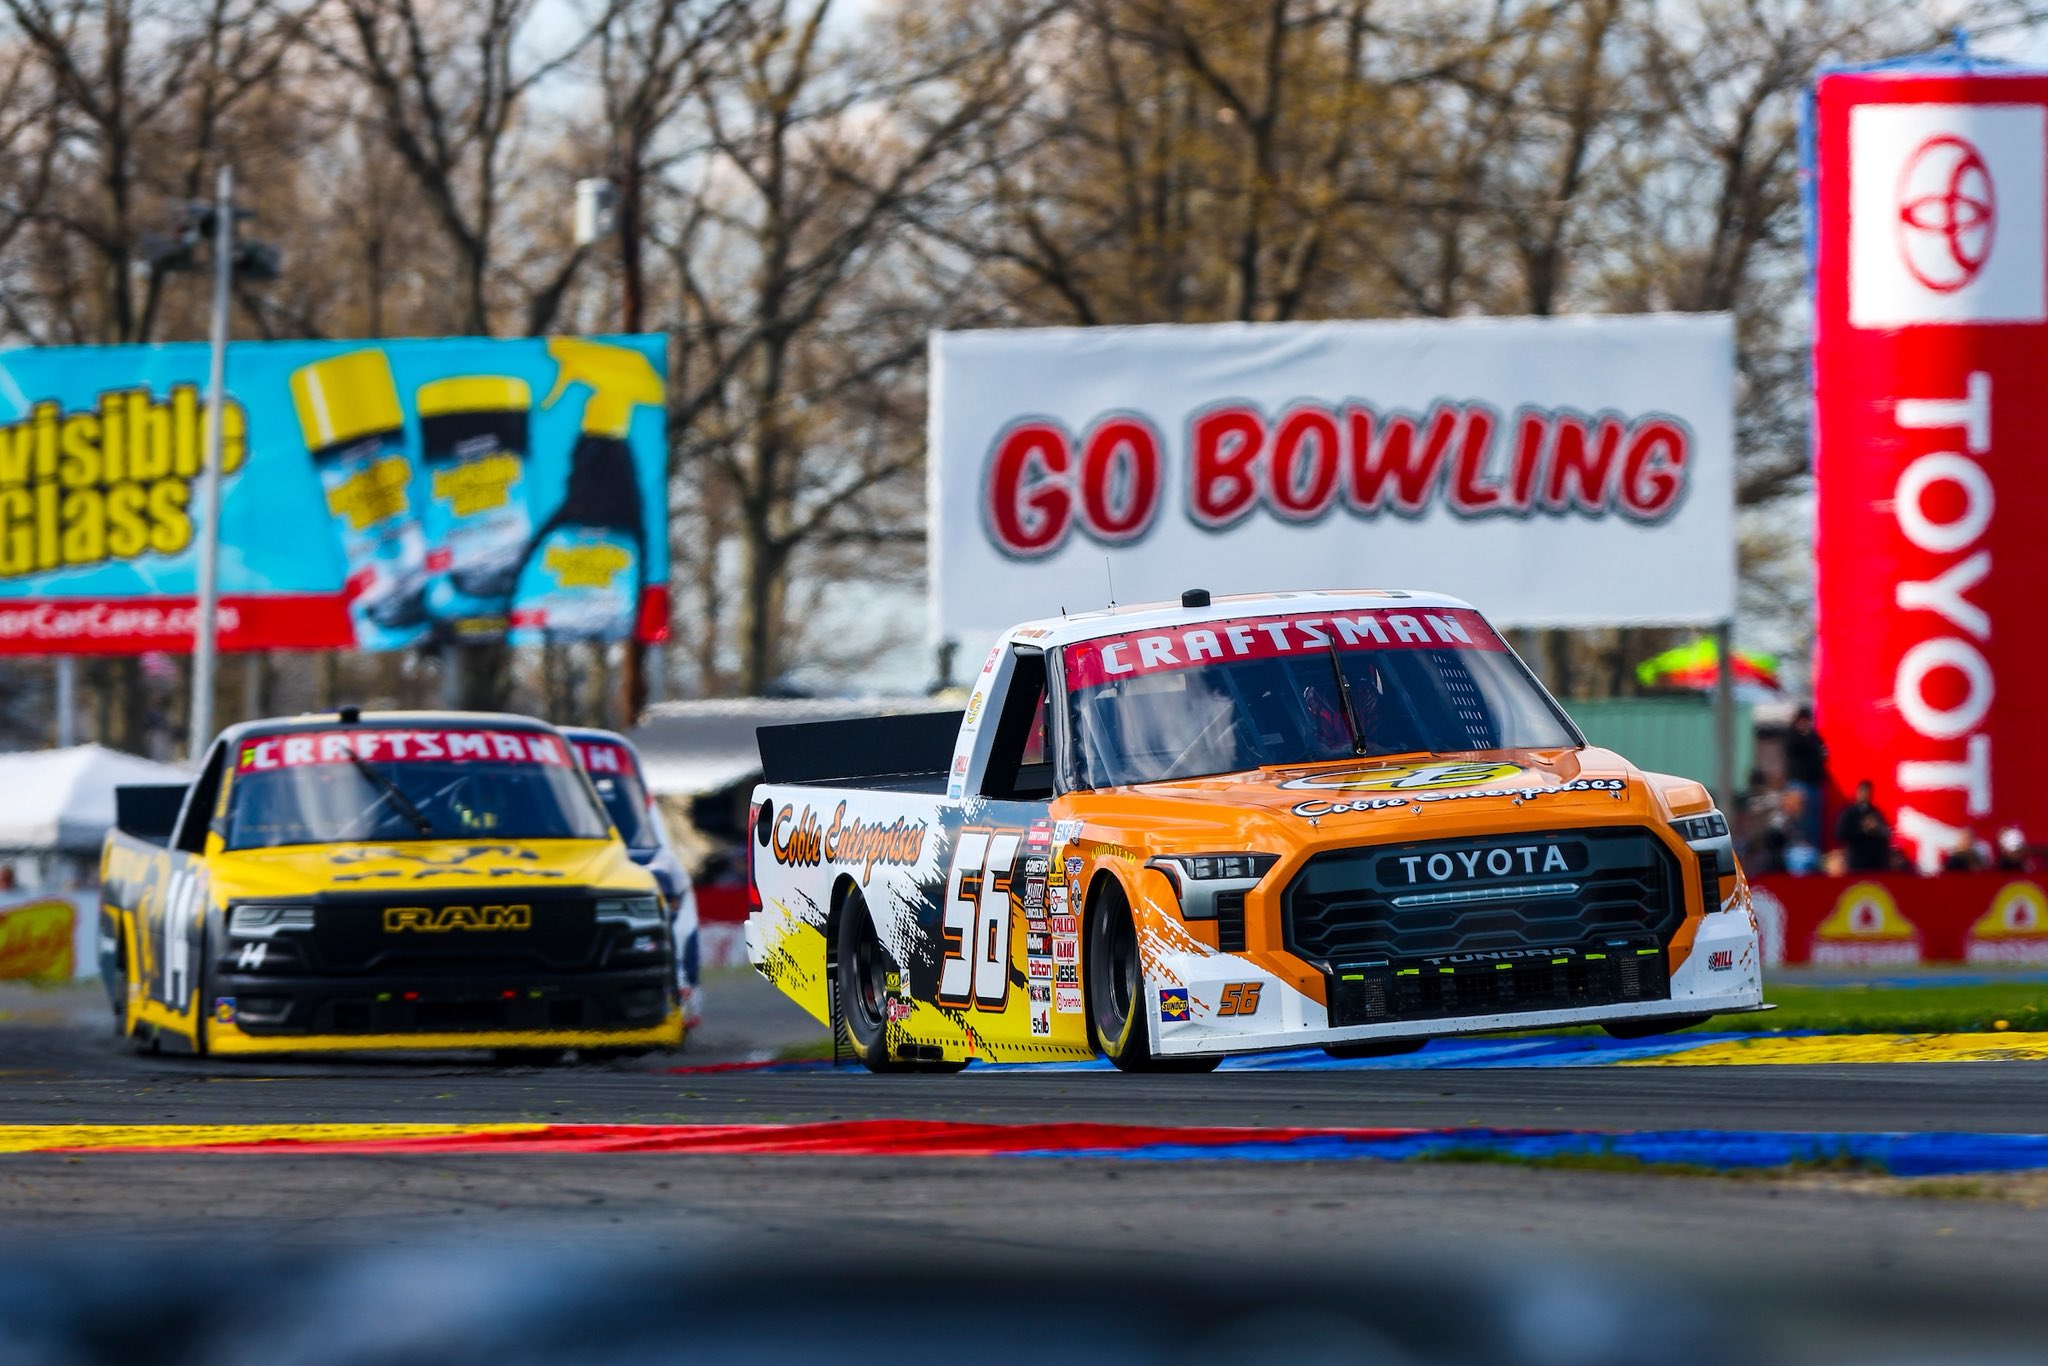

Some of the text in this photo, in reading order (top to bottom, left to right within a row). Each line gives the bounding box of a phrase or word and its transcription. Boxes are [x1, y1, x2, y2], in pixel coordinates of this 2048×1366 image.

[988, 402, 1690, 556] GO BOWLING
[1100, 614, 1474, 675] CRAFTSMAN
[254, 733, 562, 769] CRAFTSMAN
[1291, 778, 1627, 817] Coble Enterprises
[772, 799, 926, 888] Coble Enterprises
[1091, 843, 1137, 866] GOODYEAR
[1399, 845, 1569, 883] TOYOTA
[383, 904, 532, 933] RAM
[938, 826, 1024, 1012] 56
[1053, 918, 1076, 933] CALICO
[238, 942, 268, 969] 14
[1424, 947, 1577, 965] TUNDRA
[1714, 950, 1733, 967] HILL
[1056, 965, 1079, 983] JESEL
[1064, 996, 1081, 1007] brembo
[1162, 1000, 1188, 1012] SUNOCO
[1216, 982, 1264, 1017] 56
